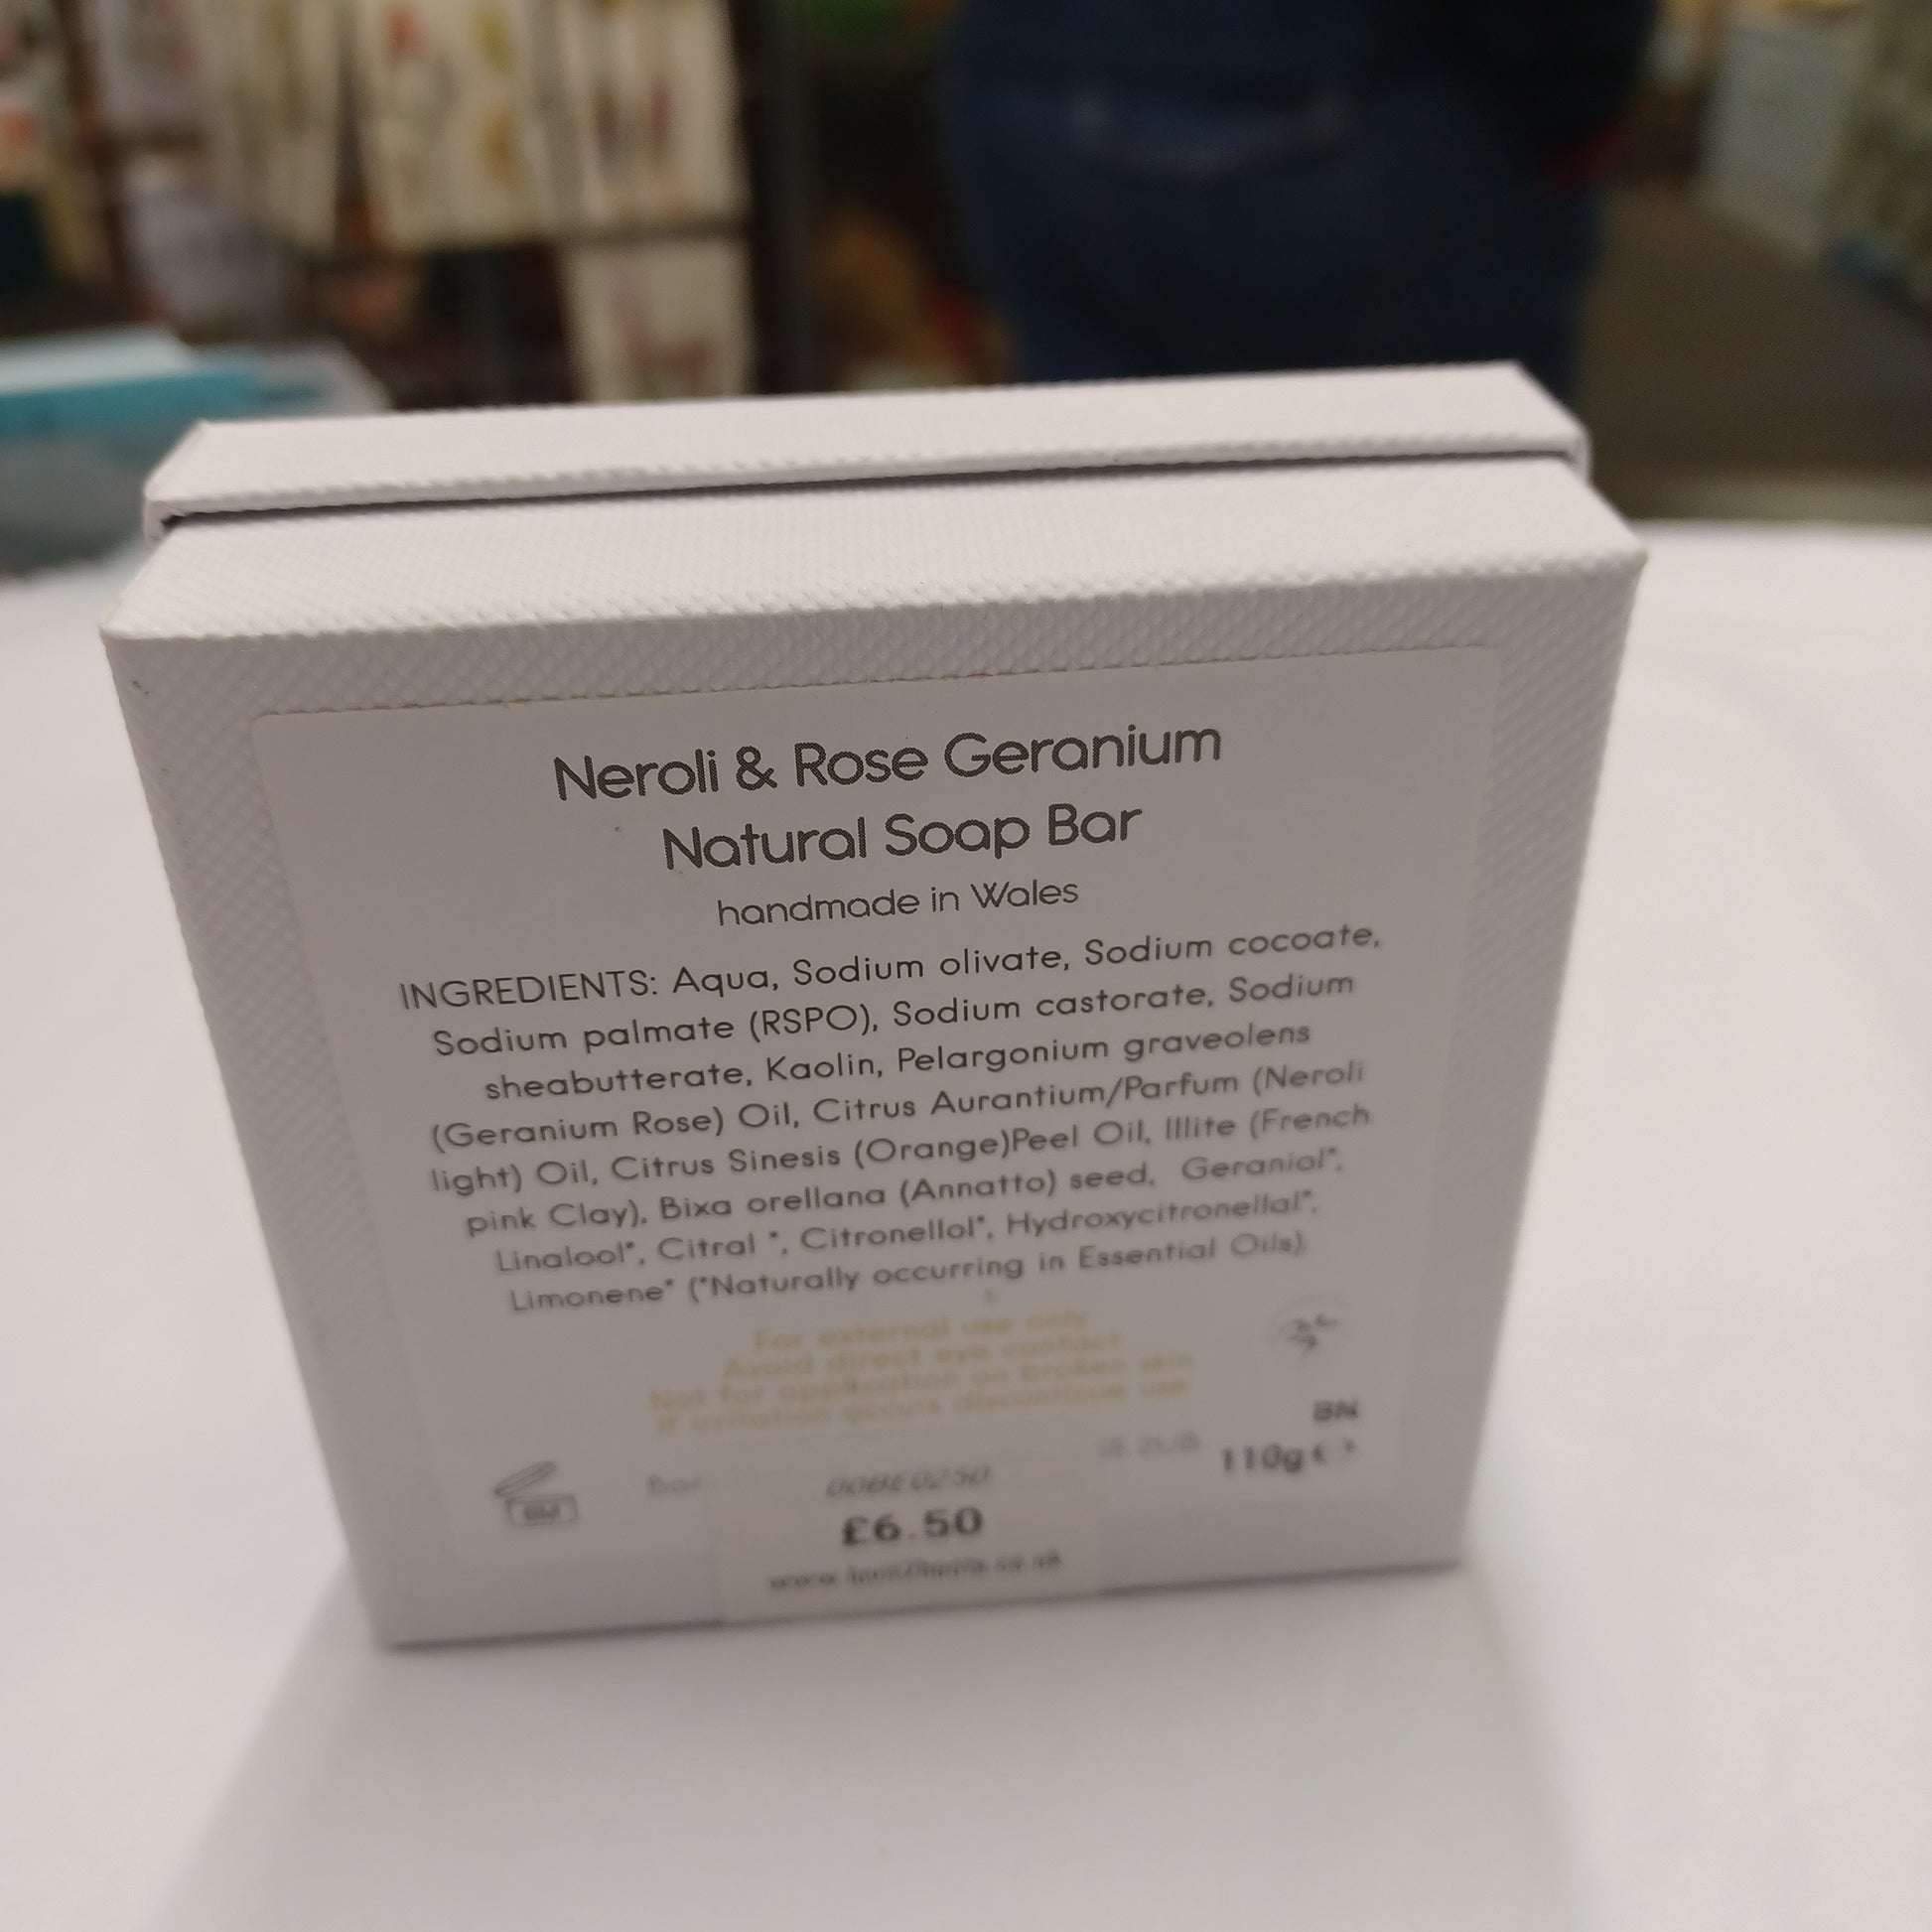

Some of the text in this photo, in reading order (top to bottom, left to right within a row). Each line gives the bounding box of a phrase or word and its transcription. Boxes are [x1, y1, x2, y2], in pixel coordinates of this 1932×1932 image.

[554, 724, 1221, 800] Neroli & Rose Geranium
[663, 803, 1143, 871] Natural Soap Bar
[718, 880, 1079, 926] handmade in Wales
[401, 924, 1380, 1010] INGREDIENTS: Aqua, Sodium olivate, Sodium cocoate,
[434, 974, 1354, 1056] Sodium palmate (RSPO), Sodium castorate, Sodium
[485, 1023, 1311, 1100] sheabutterate, Kaolin, Pelargonium graveolens
[432, 1059, 1364, 1155] (Geranium Rose) Oil, Citrus Aurantium/Parfum (Neroli
[432, 1103, 1370, 1196] light) Oil, Citrus Sinesis (Orange)Peel Oil, Illite (French
[467, 1208, 535, 1239] pink
[550, 1198, 647, 1230] Clay),
[660, 1195, 732, 1220] Bixa
[748, 1185, 885, 1214] orellana
[899, 1169, 1056, 1209] (Annatto)
[1070, 1163, 1155, 1190] seed,
[658, 1233, 755, 1261] Citral
[874, 1256, 1024, 1286] occurring
[1039, 1250, 1065, 1271] in
[1079, 1237, 1215, 1271] Essential
[842, 1506, 983, 1546] £6.50
